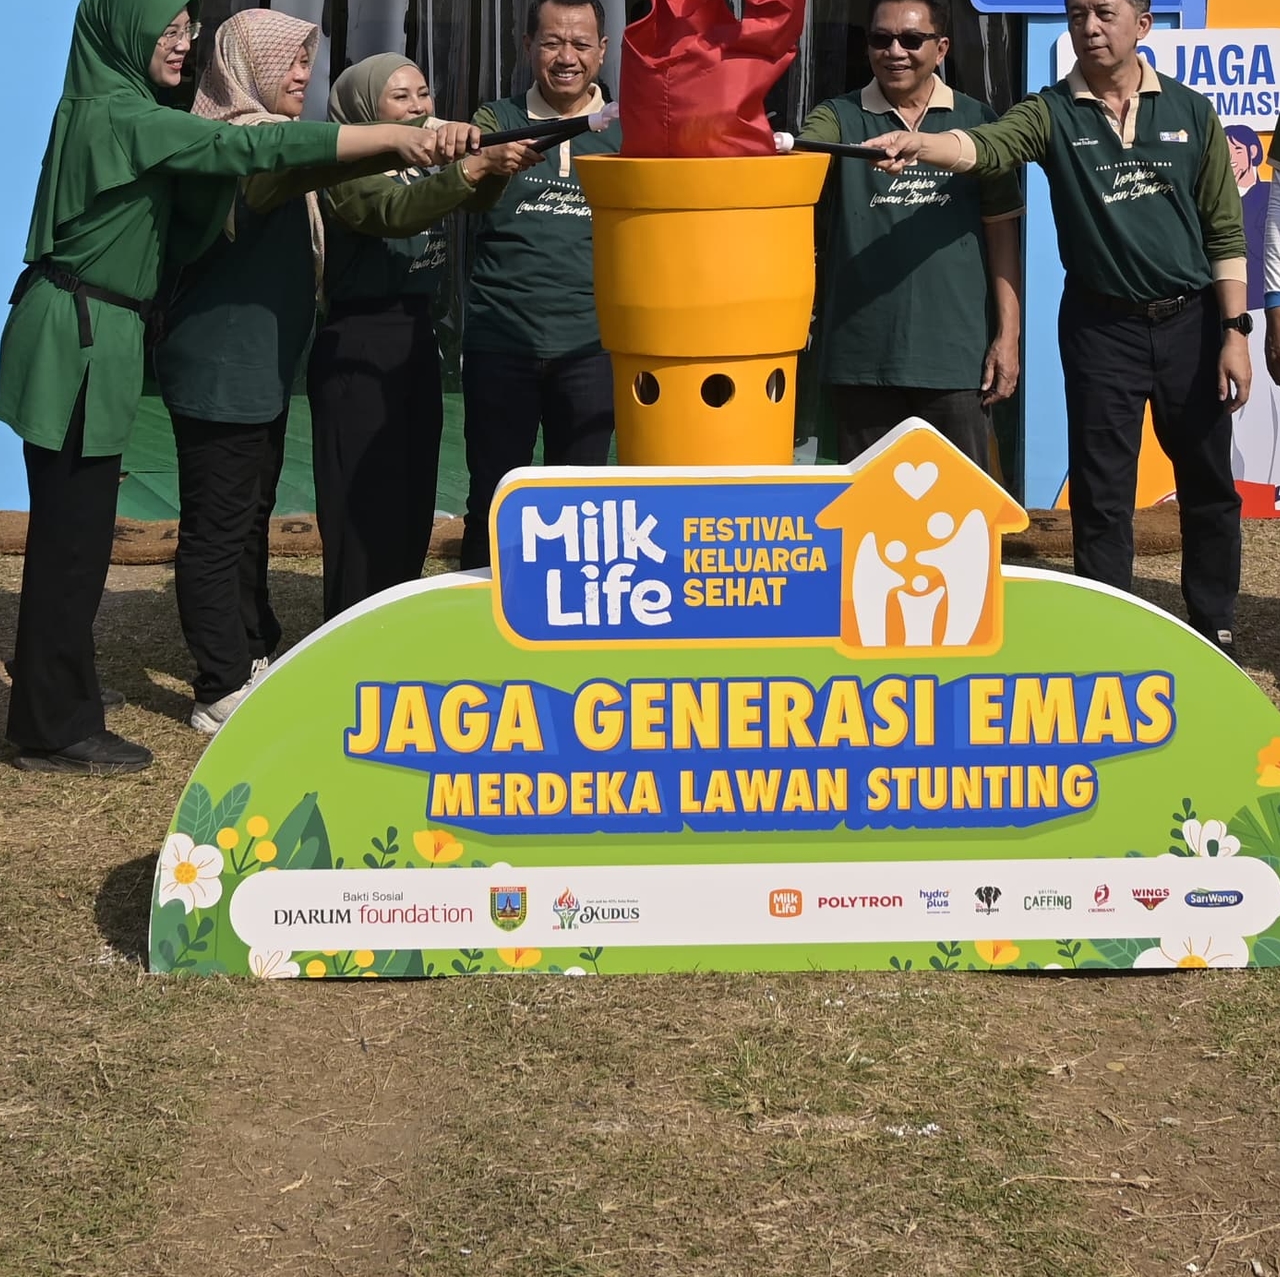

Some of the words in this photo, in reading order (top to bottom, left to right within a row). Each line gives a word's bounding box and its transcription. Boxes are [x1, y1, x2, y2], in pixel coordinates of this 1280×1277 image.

[1173, 44, 1276, 86] JAGA
[521, 499, 667, 565] Milk
[683, 516, 813, 543] FESTIVAL
[683, 547, 827, 574] KELUARGA
[545, 564, 673, 627] Life
[683, 578, 787, 607] SEHAT
[347, 683, 544, 756] JAGA
[573, 678, 935, 752] GENERASI
[968, 674, 1174, 747] EMAS
[430, 769, 662, 818] MERDEKA
[679, 766, 847, 814] LAWAN
[866, 763, 1096, 811] STUNTING
[342, 892, 369, 902] Bakti
[372, 891, 404, 902] Sosial
[773, 893, 798, 904] Milk
[817, 895, 903, 909] POLYTRON
[919, 889, 950, 901] hydro
[1023, 895, 1072, 911] CAFFINO
[1131, 888, 1170, 897] WINGS
[273, 909, 352, 926] DJARUM
[358, 903, 474, 924] foundation
[775, 904, 797, 914] Life
[926, 899, 949, 910] plus
